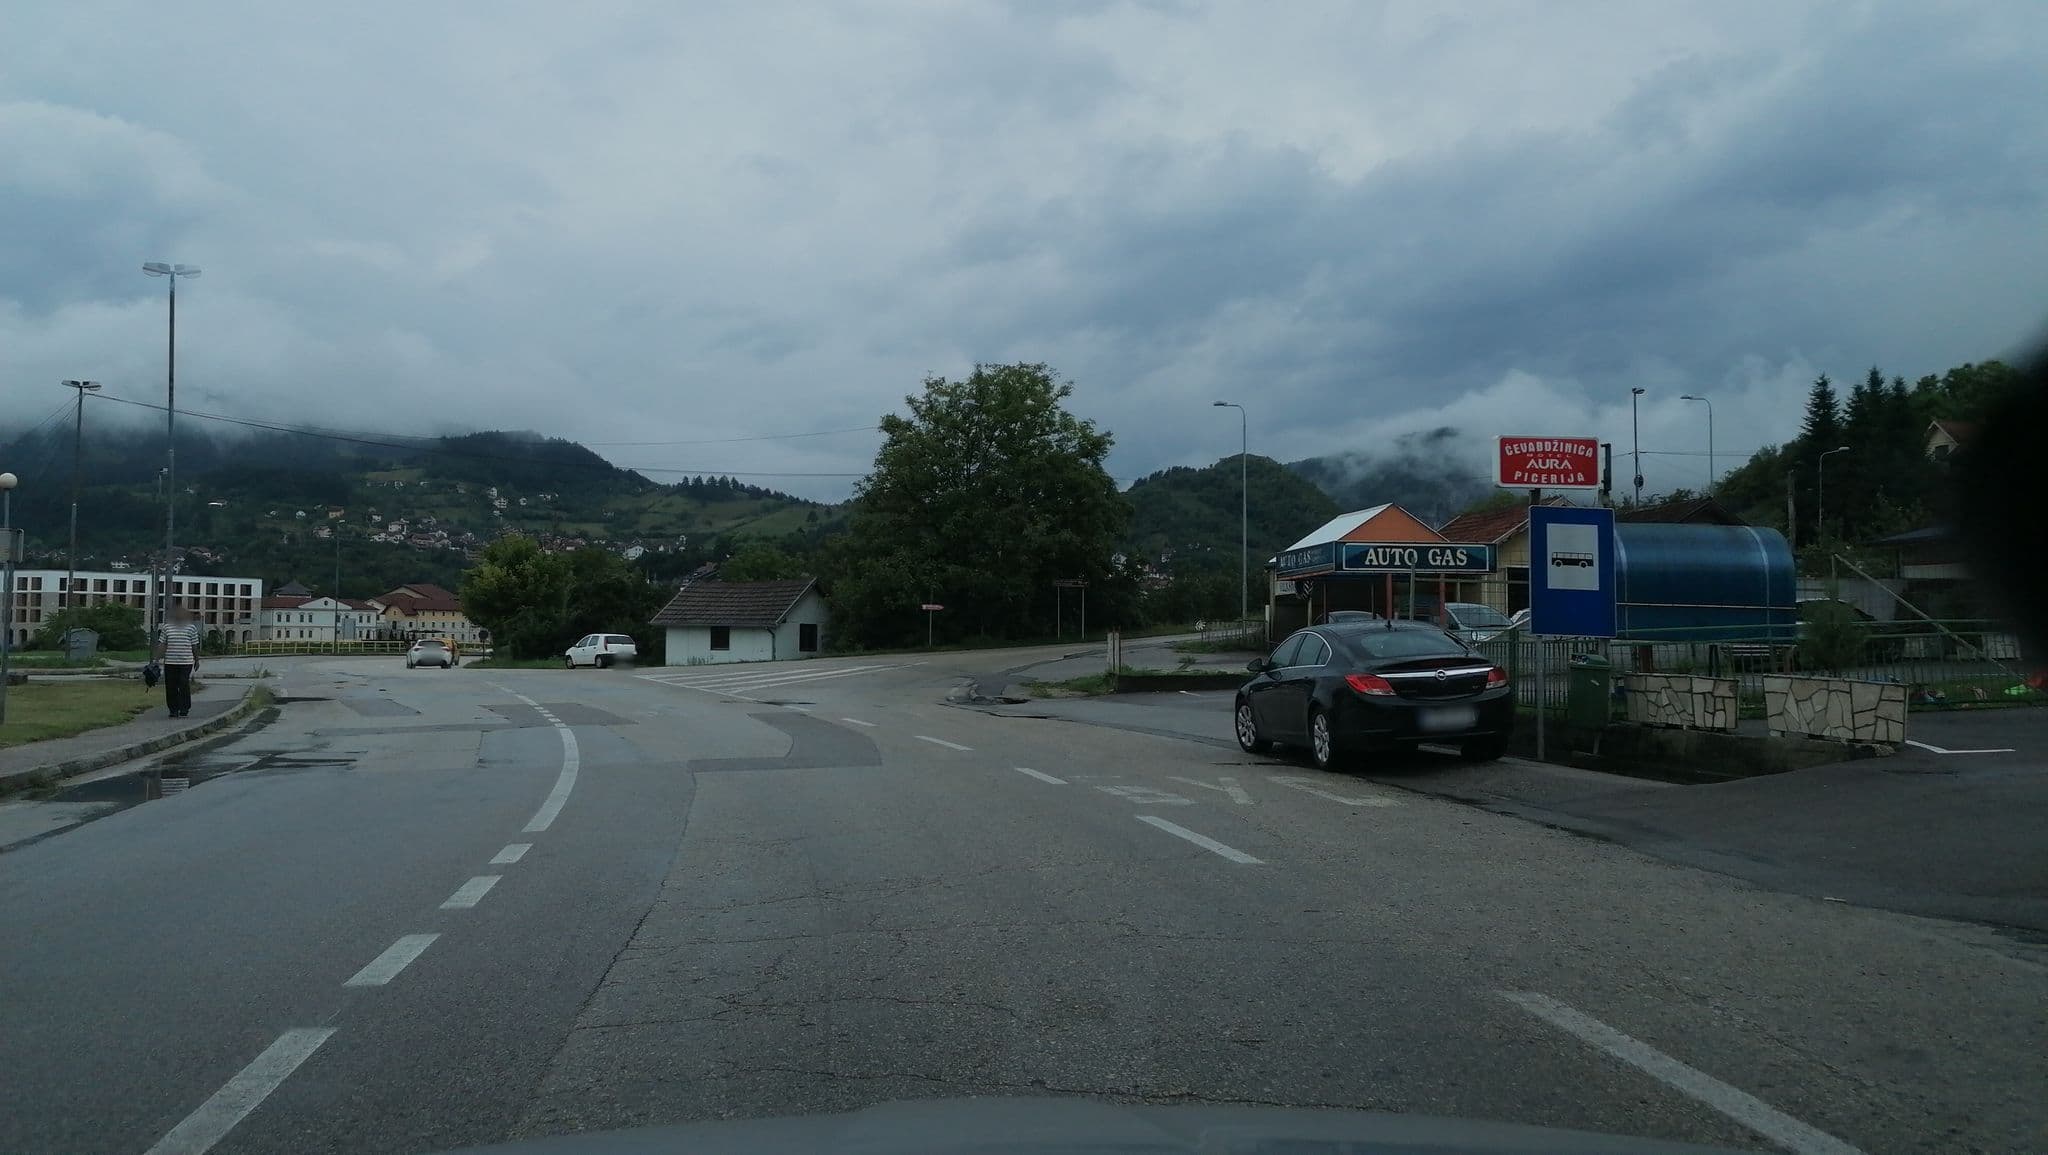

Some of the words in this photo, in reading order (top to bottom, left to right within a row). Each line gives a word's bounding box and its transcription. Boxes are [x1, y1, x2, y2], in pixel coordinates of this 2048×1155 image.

[1526, 458, 1573, 470] AURA
[1514, 471, 1585, 484] PICERIJA
[1364, 547, 1418, 566] AUTO
[1428, 547, 1468, 566] GAS
